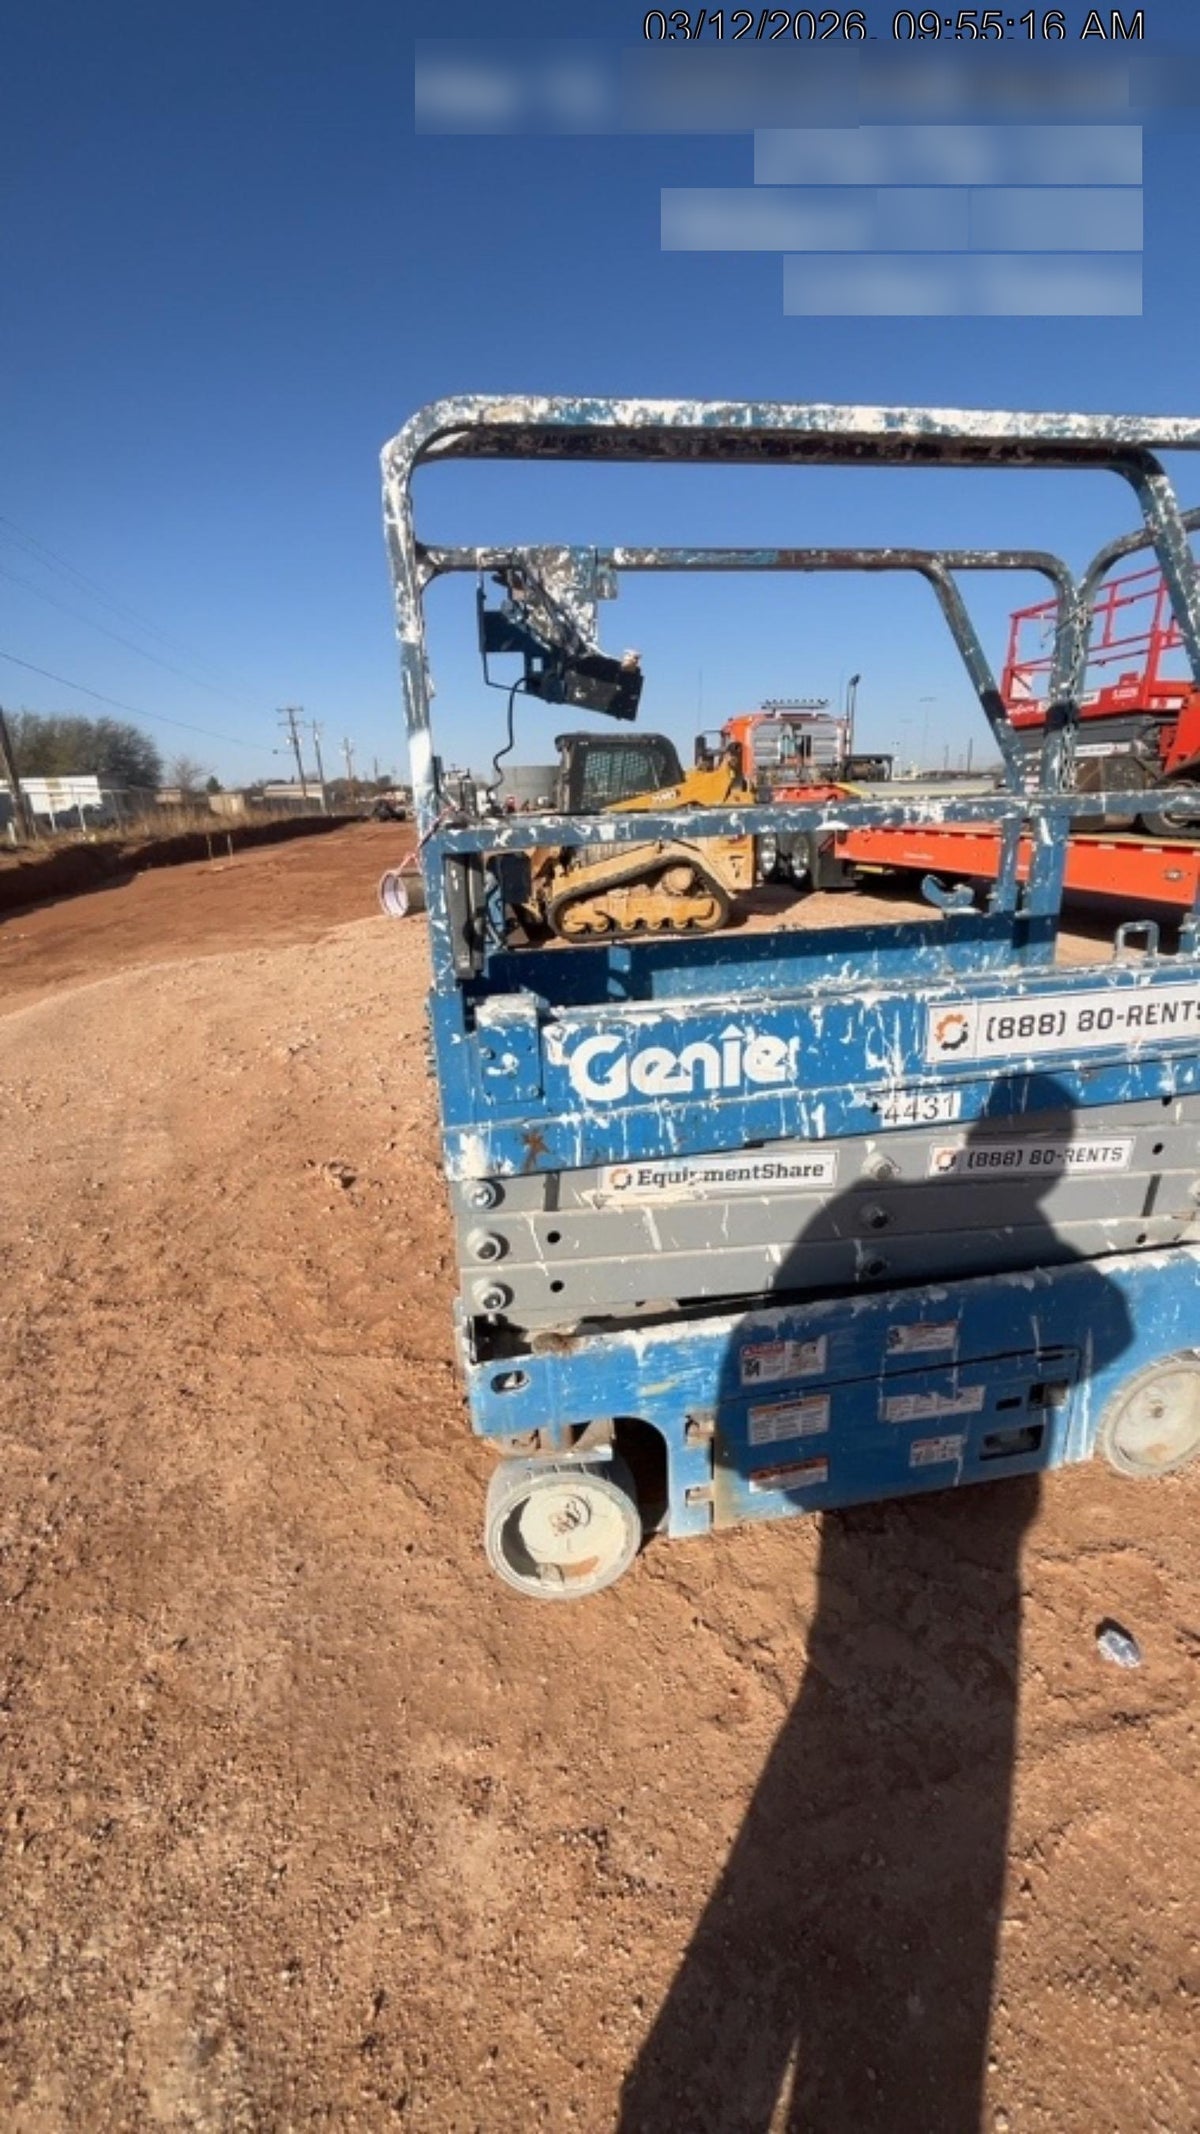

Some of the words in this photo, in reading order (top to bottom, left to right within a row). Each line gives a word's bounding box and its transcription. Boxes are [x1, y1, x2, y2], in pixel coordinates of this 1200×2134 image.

[986, 1010, 1066, 1042] (888)
[1077, 1000, 1200, 1032] 80-RENT
[569, 1023, 788, 1101] Genie
[884, 1092, 954, 1123] 4431
[967, 1150, 1023, 1169] (888)
[1029, 1146, 1124, 1165] 80-RENTS
